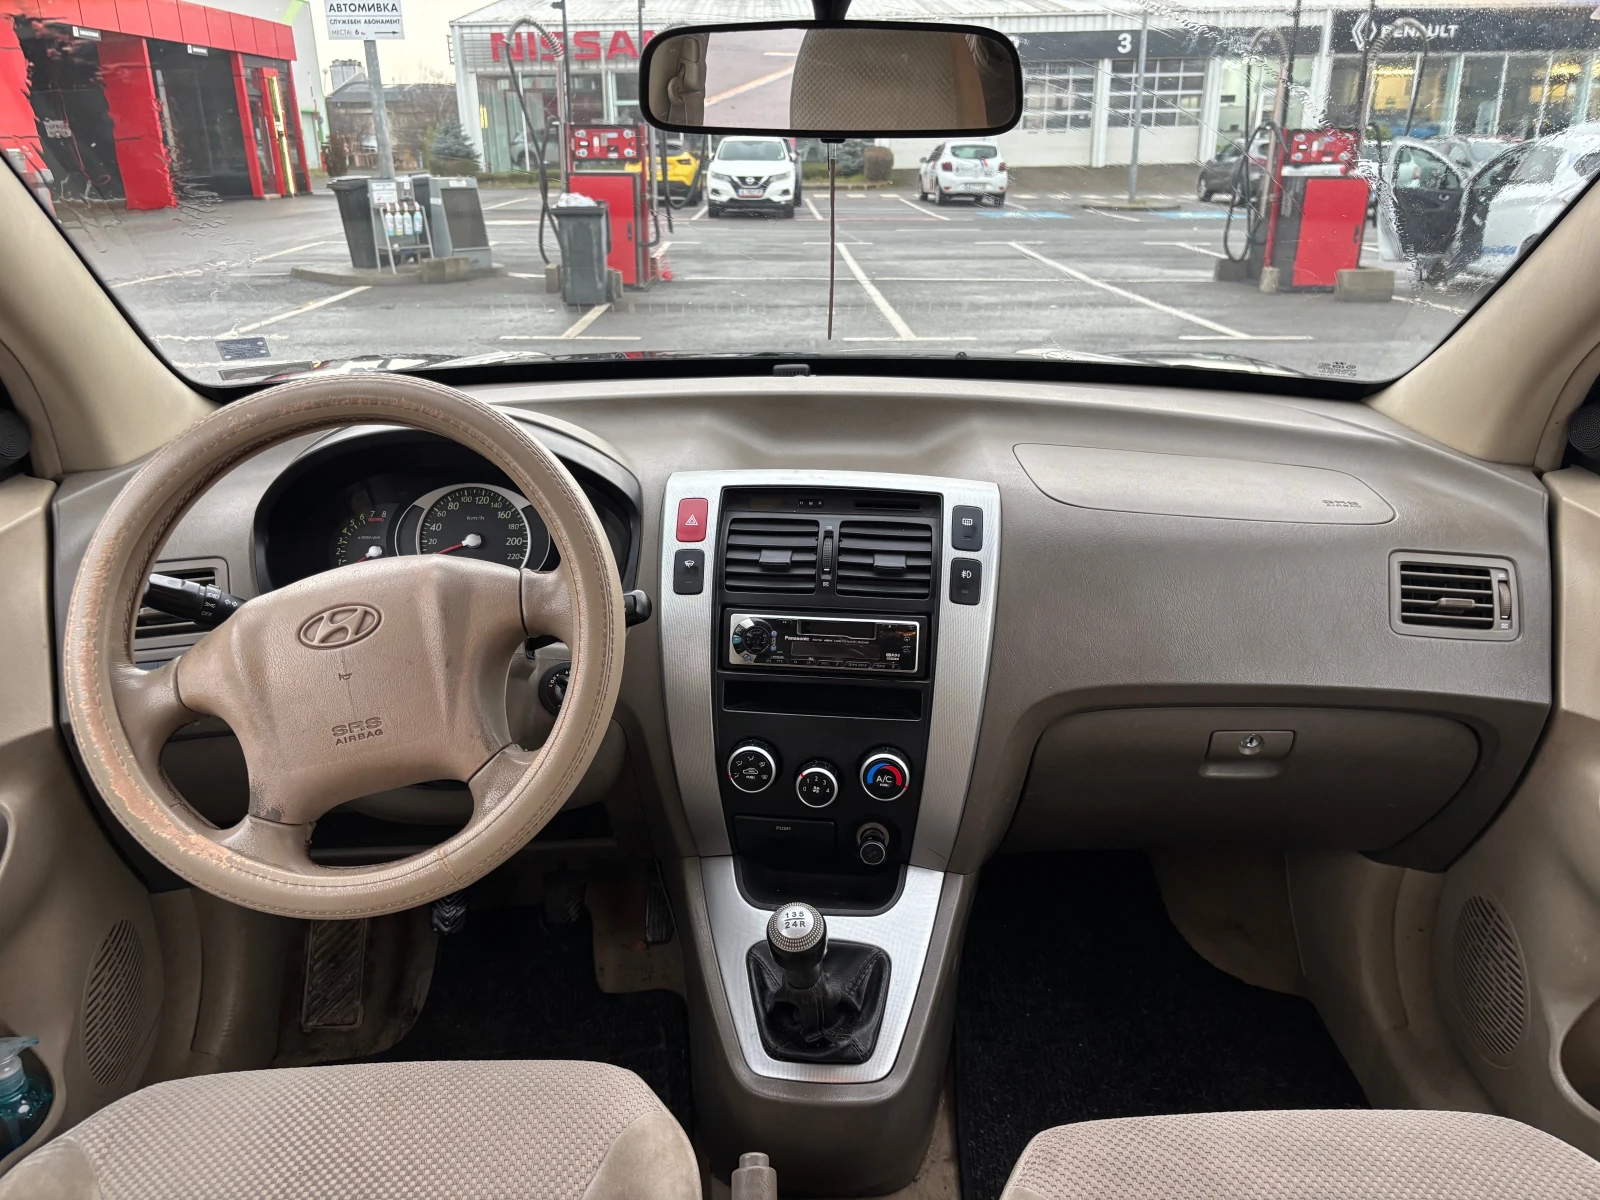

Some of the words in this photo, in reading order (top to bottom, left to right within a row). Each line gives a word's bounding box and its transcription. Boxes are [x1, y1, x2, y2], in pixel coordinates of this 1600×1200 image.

[328, 3, 399, 12] АВТОМИВКА
[490, 30, 656, 62] NISSA
[1116, 33, 1132, 54] 3
[475, 496, 490, 505] 120
[447, 502, 460, 511] 80
[359, 512, 365, 520] 6
[370, 510, 376, 518] 7
[381, 510, 387, 518] 8
[497, 511, 512, 519] 160
[429, 523, 443, 532] 40
[337, 536, 343, 545] 3
[505, 537, 523, 546] 200
[335, 547, 341, 555] 2
[338, 558, 342, 566] 1
[331, 717, 383, 737] SRS
[335, 729, 384, 746] AIRBAG
[876, 775, 893, 783] A/C
[784, 921, 791, 930] 2
[791, 920, 798, 928] 4
[799, 920, 806, 928] R
